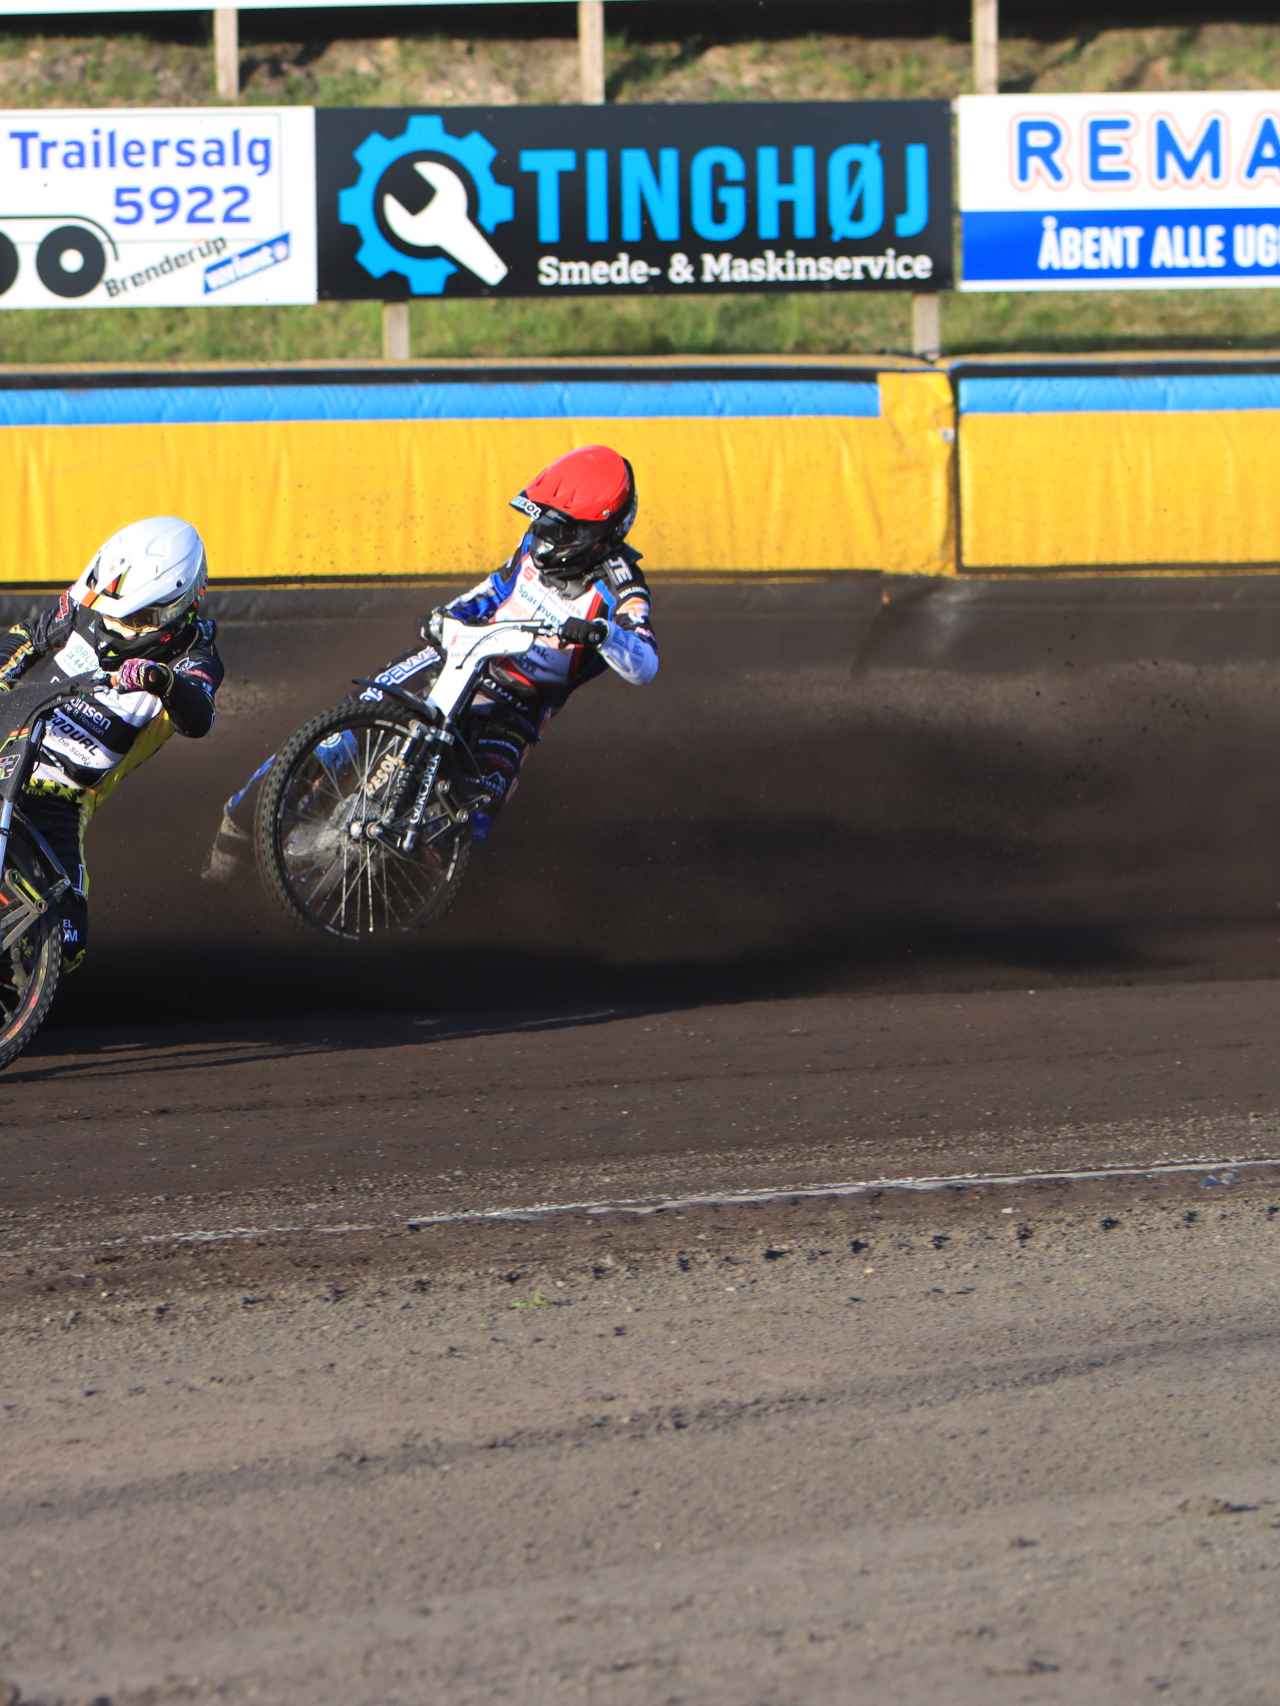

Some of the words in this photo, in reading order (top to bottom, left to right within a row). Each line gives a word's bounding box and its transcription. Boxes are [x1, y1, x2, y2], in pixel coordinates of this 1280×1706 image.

[9, 129, 273, 176] Trailersalg
[1017, 116, 1280, 183] REMA
[113, 186, 252, 225] 5922
[520, 139, 929, 243] TINGHØJ
[104, 236, 228, 298] Brenderup
[537, 252, 661, 286] Smede-
[667, 252, 696, 284] &
[701, 247, 934, 283] Maskinservice
[1037, 215, 1145, 271] ÅBENT
[1150, 225, 1227, 269] ALLE
[1232, 223, 1280, 269] UG
